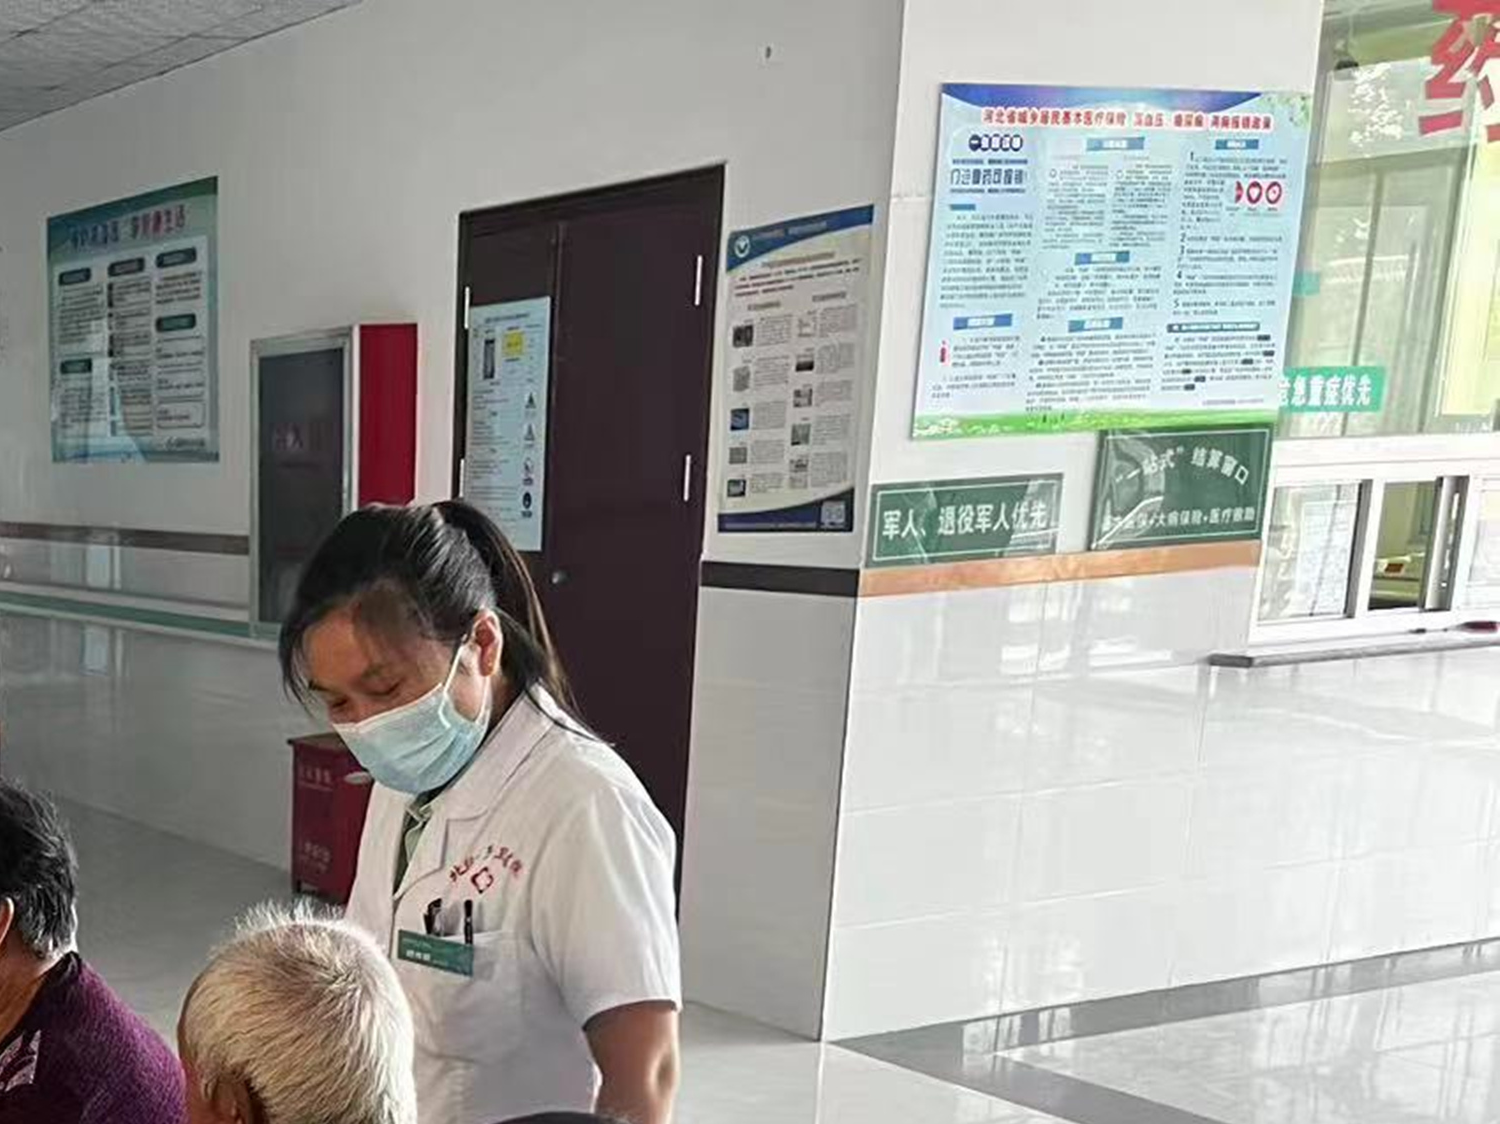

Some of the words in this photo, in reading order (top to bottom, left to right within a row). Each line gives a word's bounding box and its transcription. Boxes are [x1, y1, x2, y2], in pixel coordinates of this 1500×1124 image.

[882, 502, 1047, 541] 军人、退役军人优先
